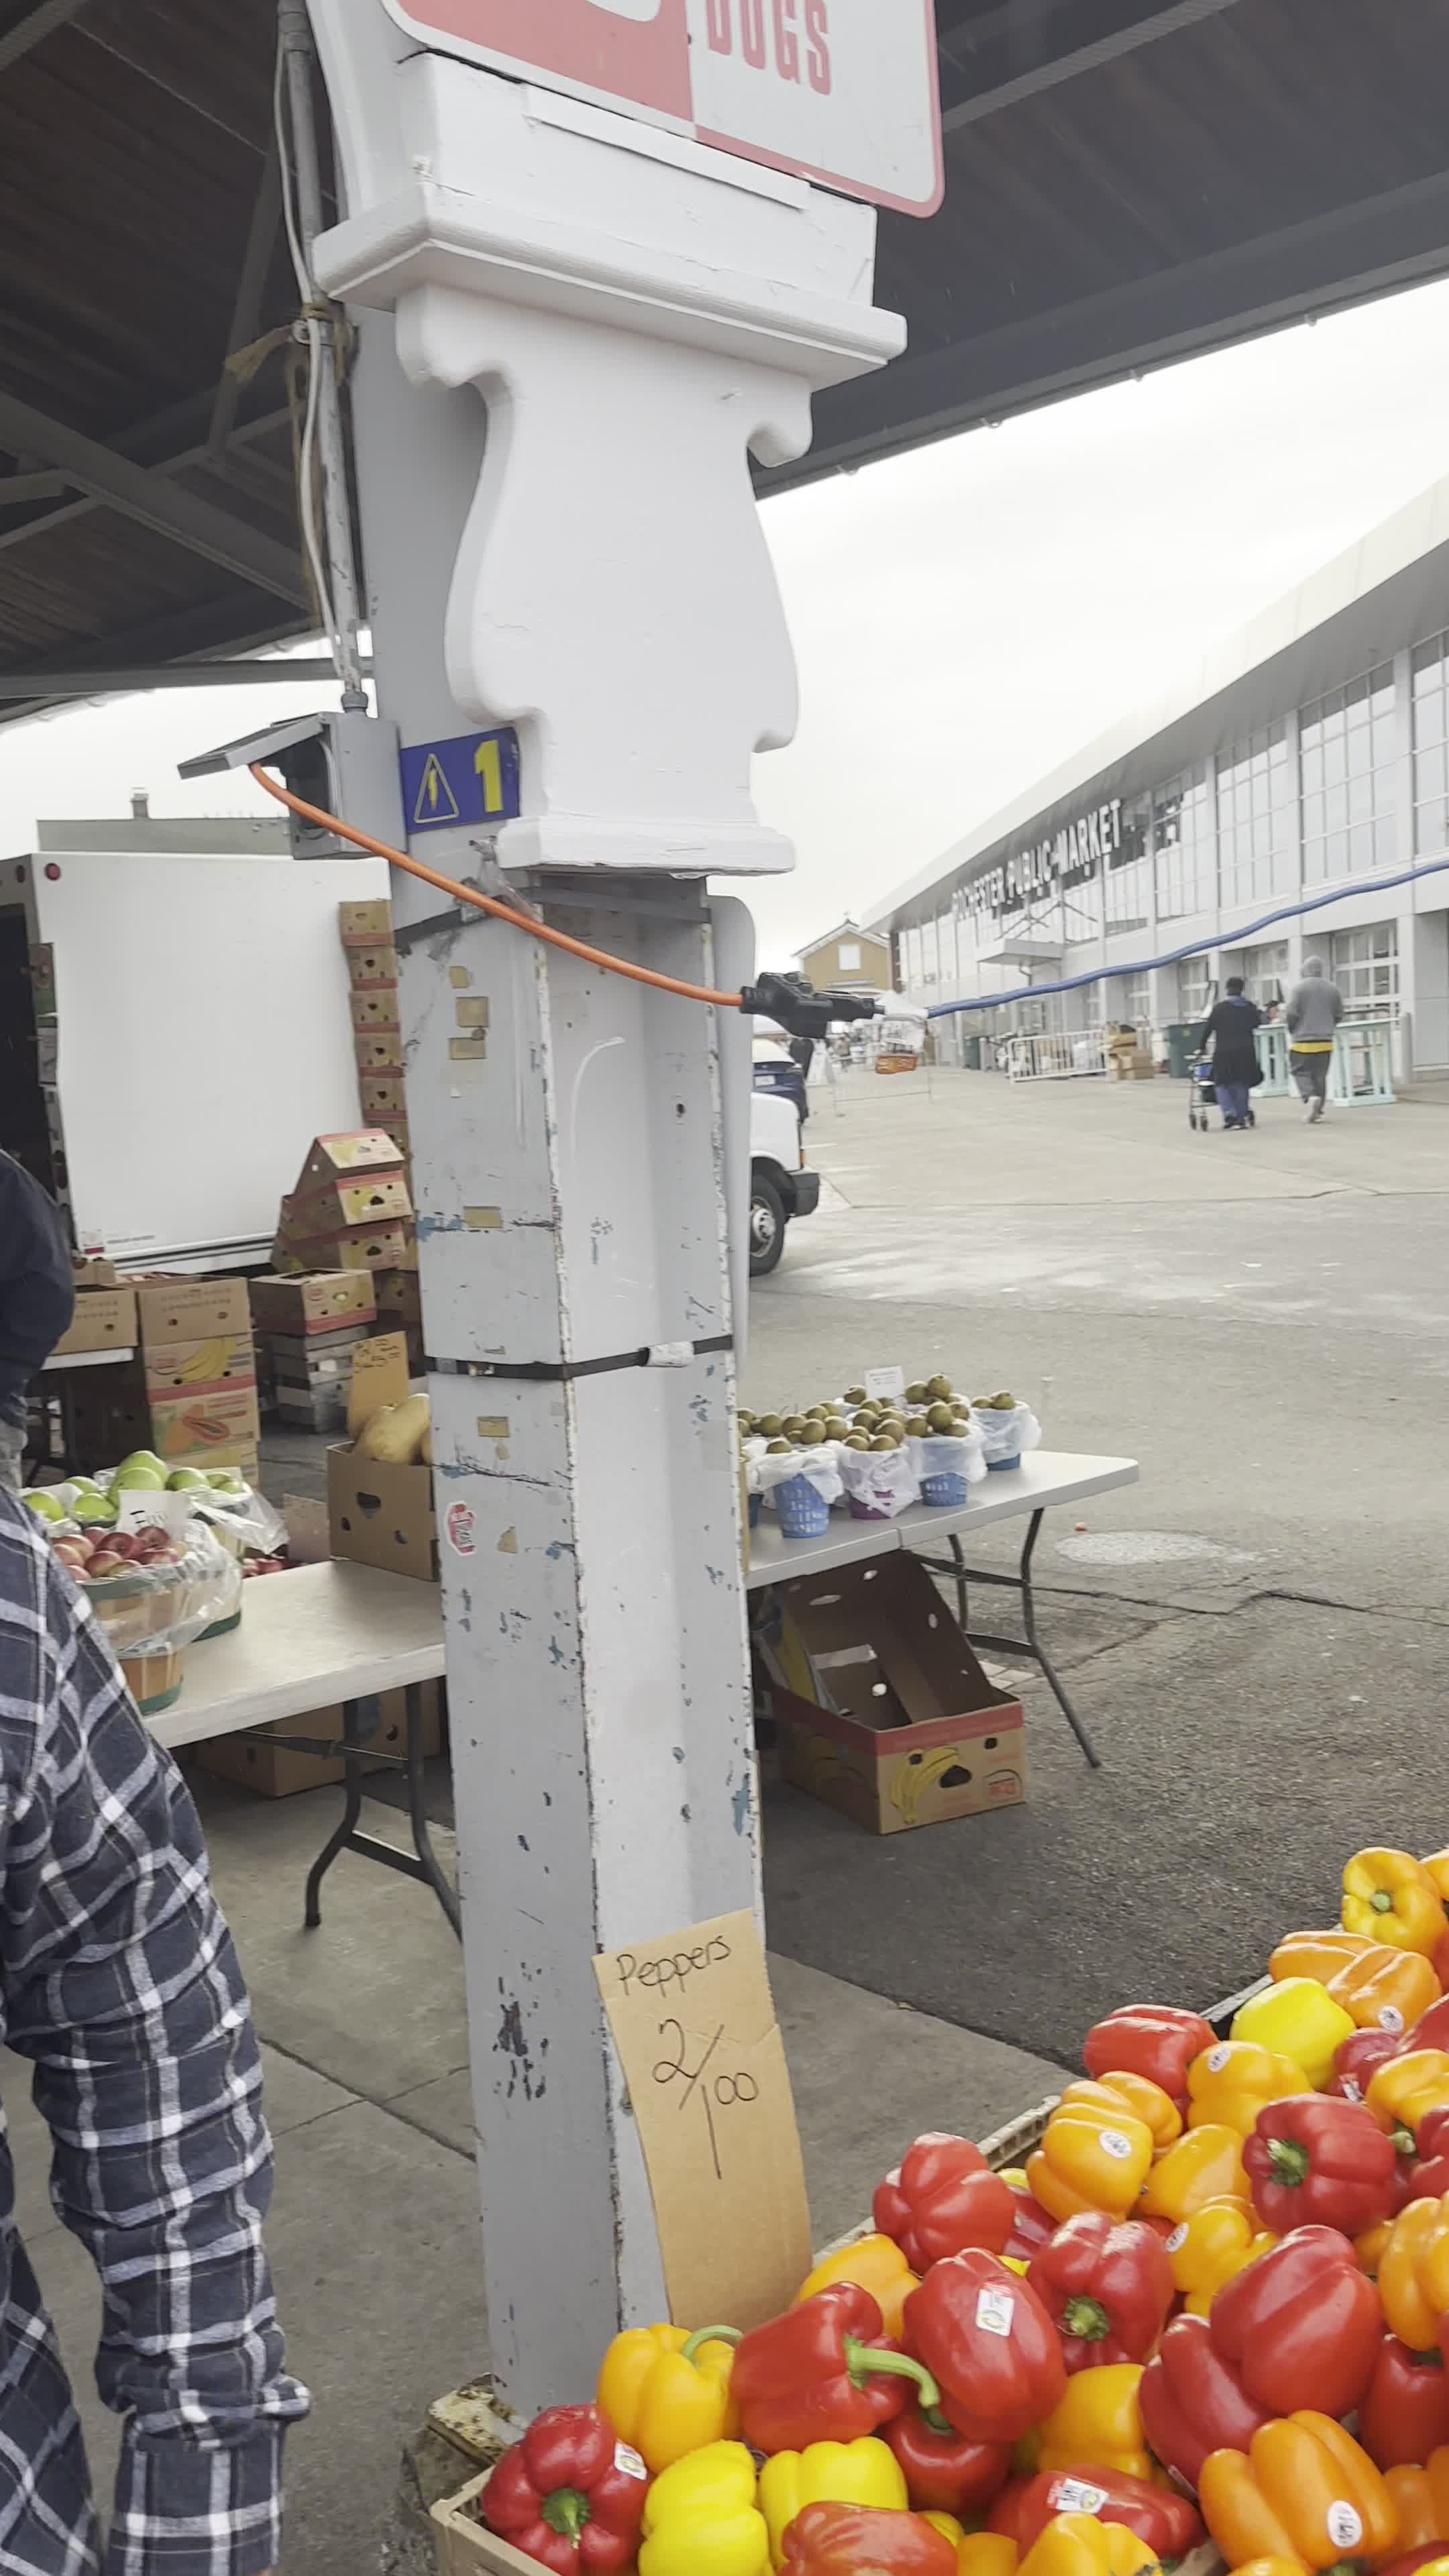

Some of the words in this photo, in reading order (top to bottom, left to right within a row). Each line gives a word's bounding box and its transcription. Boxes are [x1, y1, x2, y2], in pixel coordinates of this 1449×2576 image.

[706, 0, 831, 95] DOGS
[474, 740, 503, 812] 1
[1008, 839, 1052, 900] PUBLIC
[1057, 798, 1121, 875] MARKET
[616, 1935, 732, 1998] Peppers
